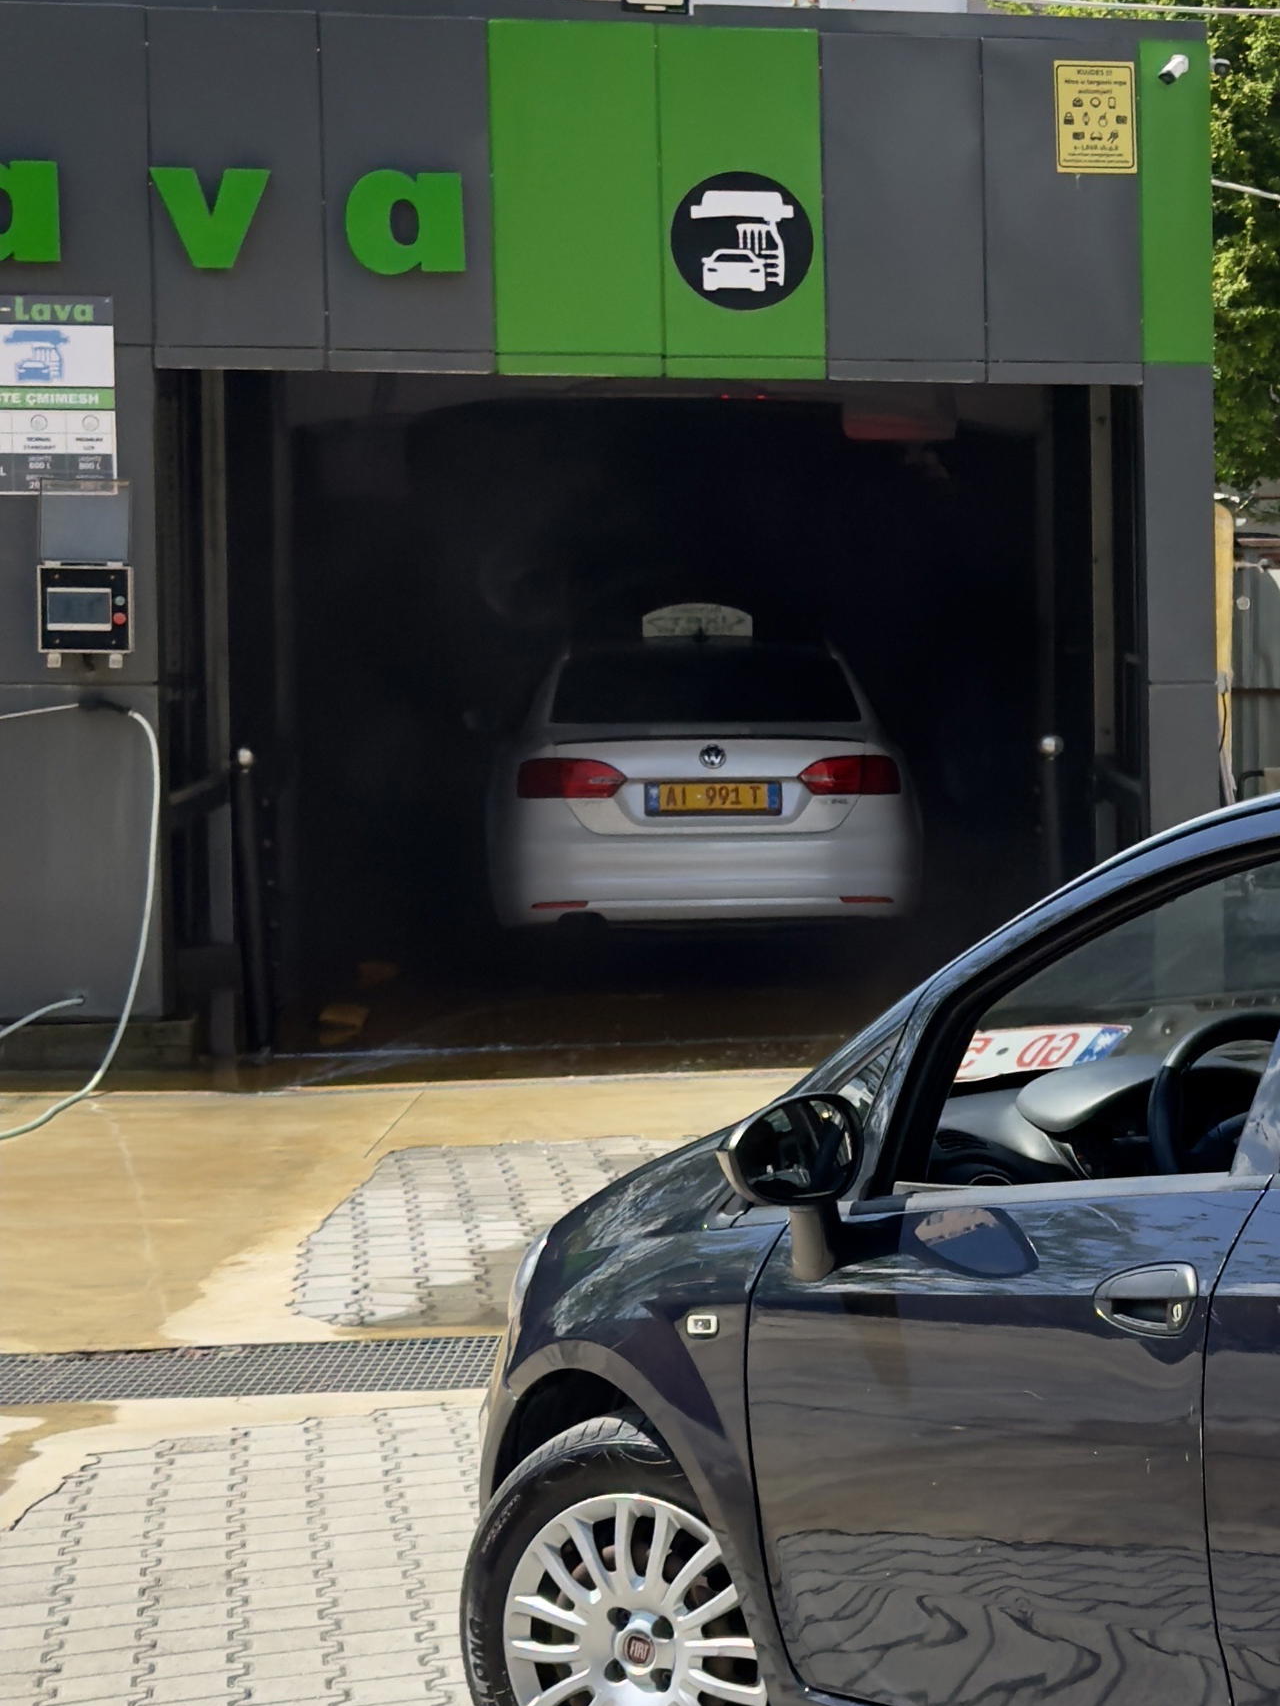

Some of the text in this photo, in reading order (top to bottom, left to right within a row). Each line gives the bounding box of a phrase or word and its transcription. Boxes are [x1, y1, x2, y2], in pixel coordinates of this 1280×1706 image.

[0, 393, 20, 404] TE
[666, 785, 761, 807] AI 991 T
